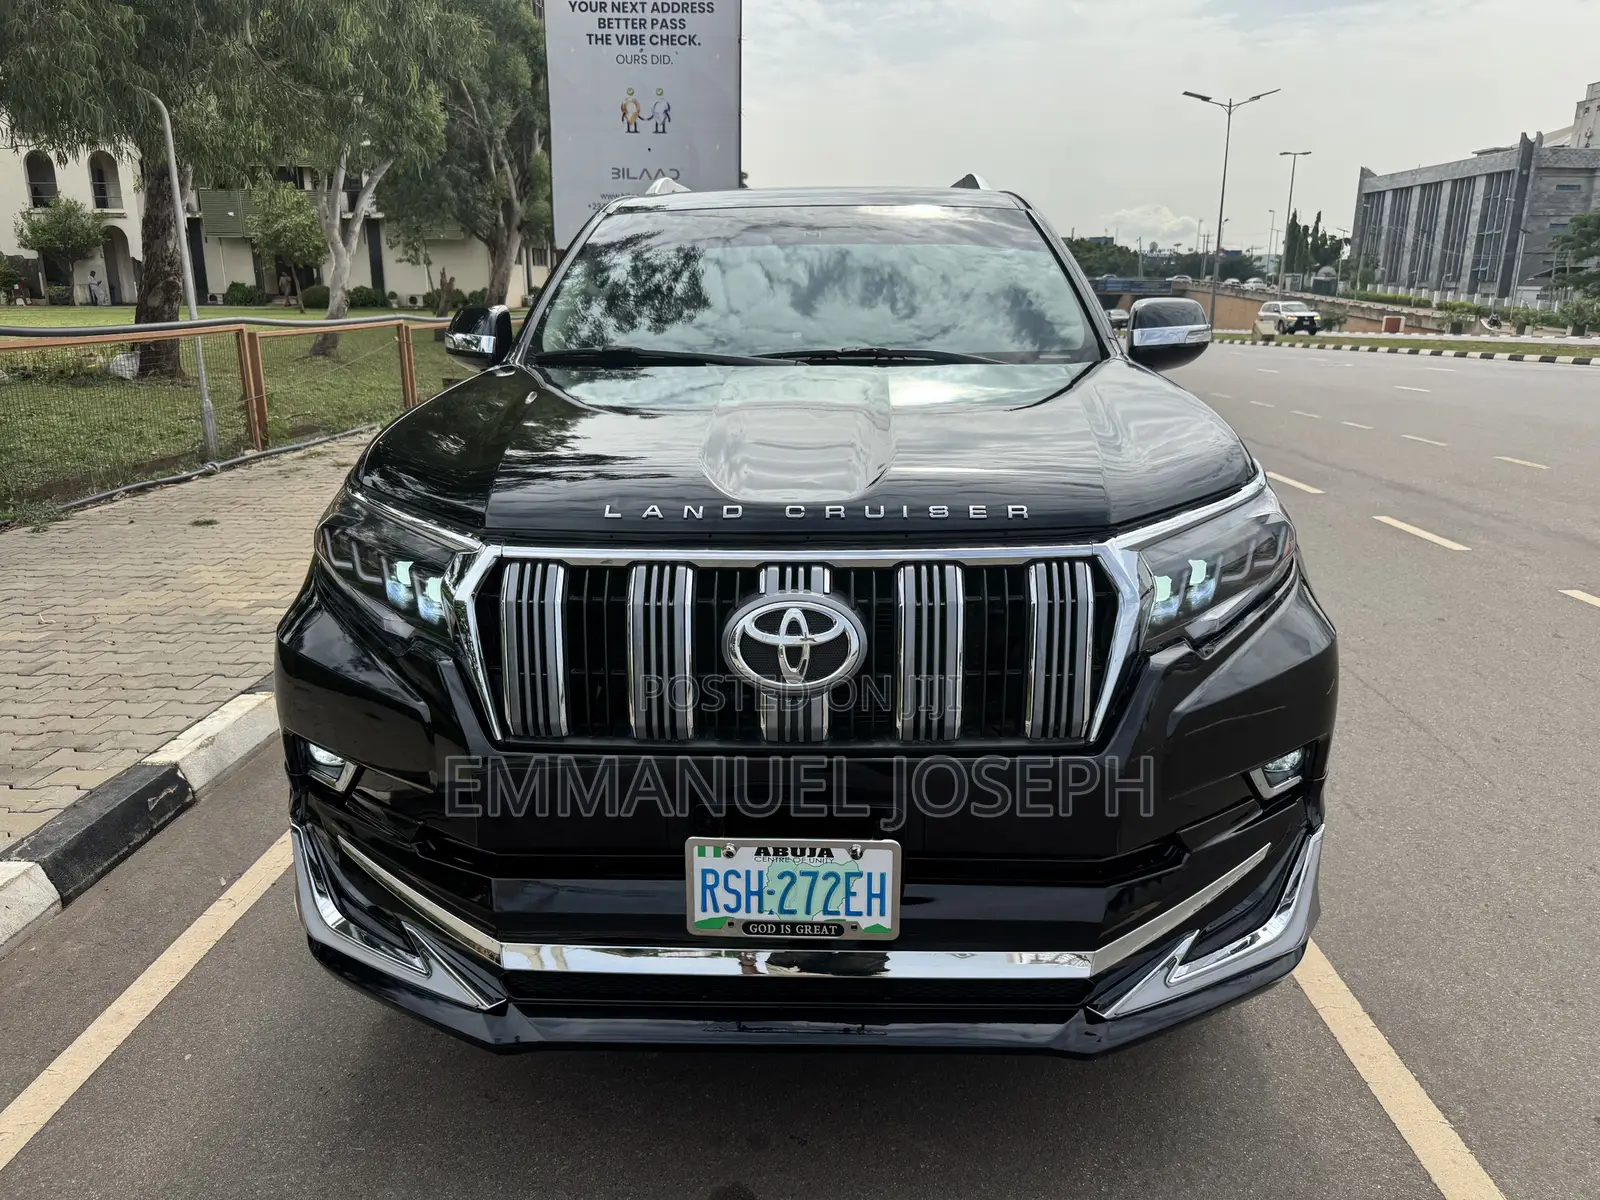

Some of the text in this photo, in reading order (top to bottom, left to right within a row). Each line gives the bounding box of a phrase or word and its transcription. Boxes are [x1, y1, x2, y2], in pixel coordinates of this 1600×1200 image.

[569, 1, 715, 14] YOUR NEXT ADDRESS
[598, 18, 687, 30] BETTER PASS
[586, 33, 702, 46] THE VIBE CHECK.
[616, 54, 674, 65] OURS DID.
[604, 504, 1030, 520] LAND CRUISER
[754, 847, 834, 858] ABUJA
[750, 924, 838, 935] GOD IS GREAT
